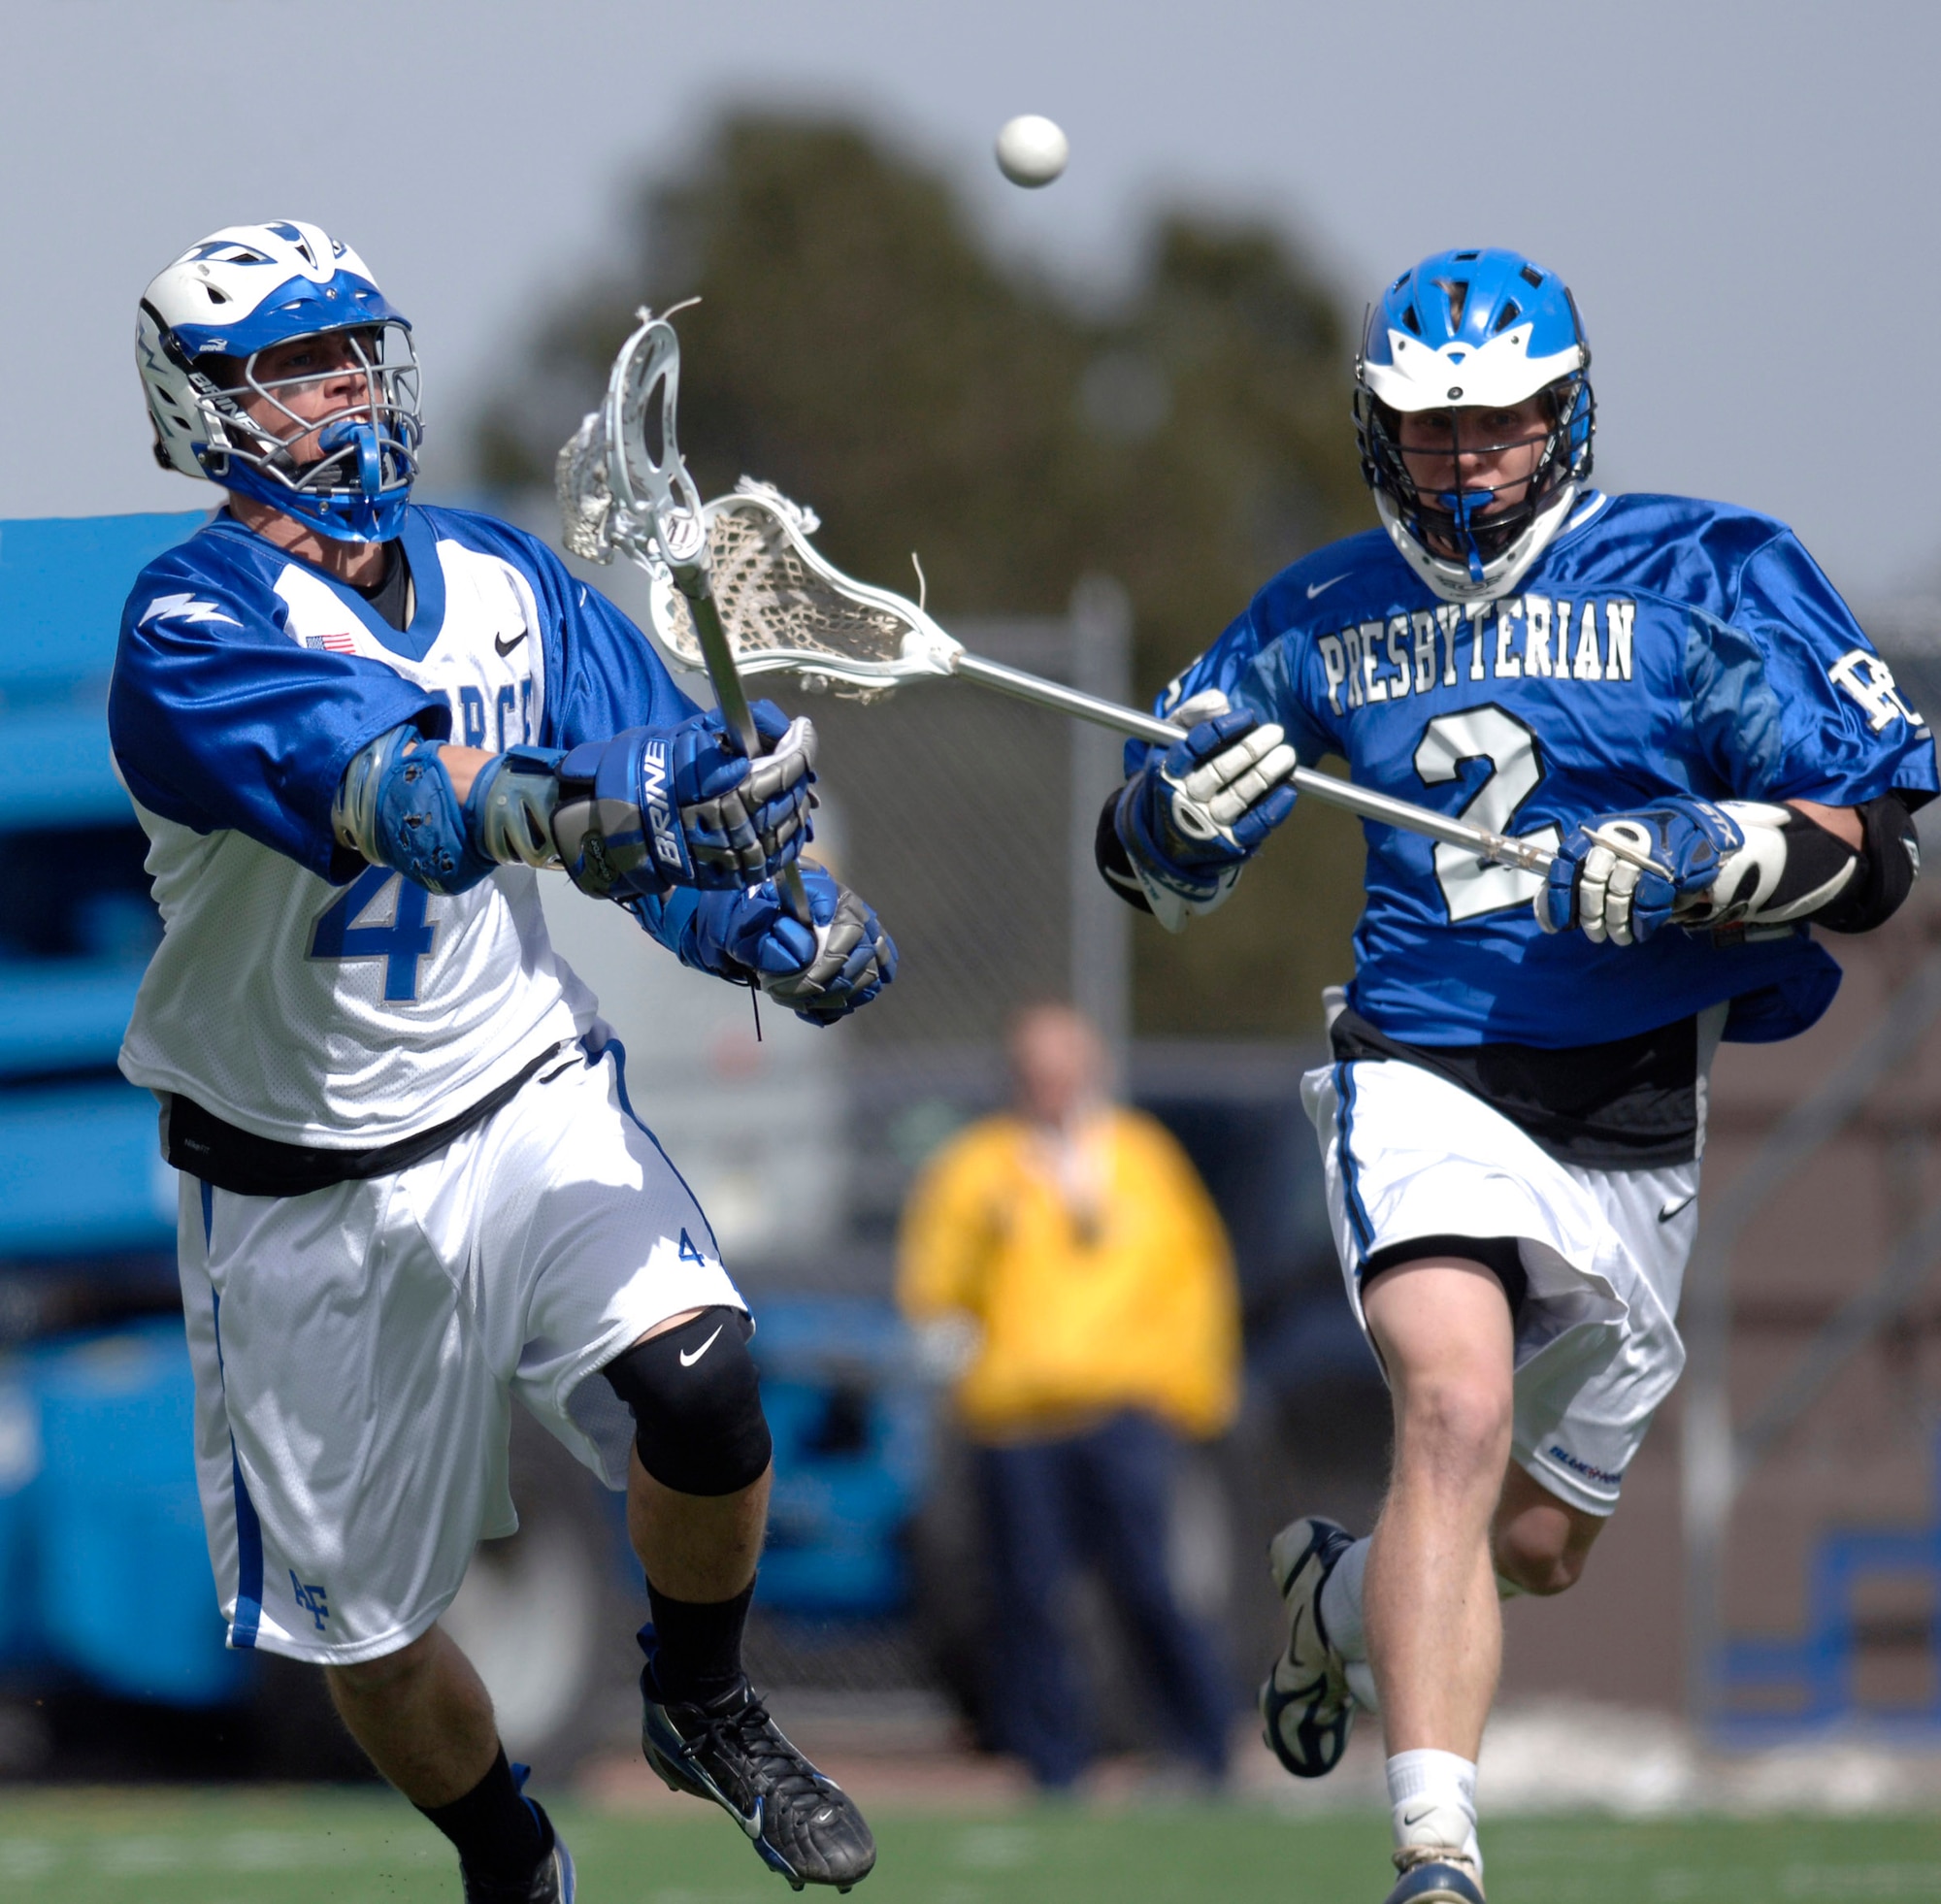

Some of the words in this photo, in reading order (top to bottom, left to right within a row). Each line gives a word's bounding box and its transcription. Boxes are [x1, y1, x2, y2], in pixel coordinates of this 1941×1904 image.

[1318, 594, 1636, 716] PRESBYTERIAN
[644, 740, 682, 869] BRINE
[1412, 701, 1564, 923] 2
[305, 864, 441, 1006] 4
[678, 1227, 706, 1267] 4
